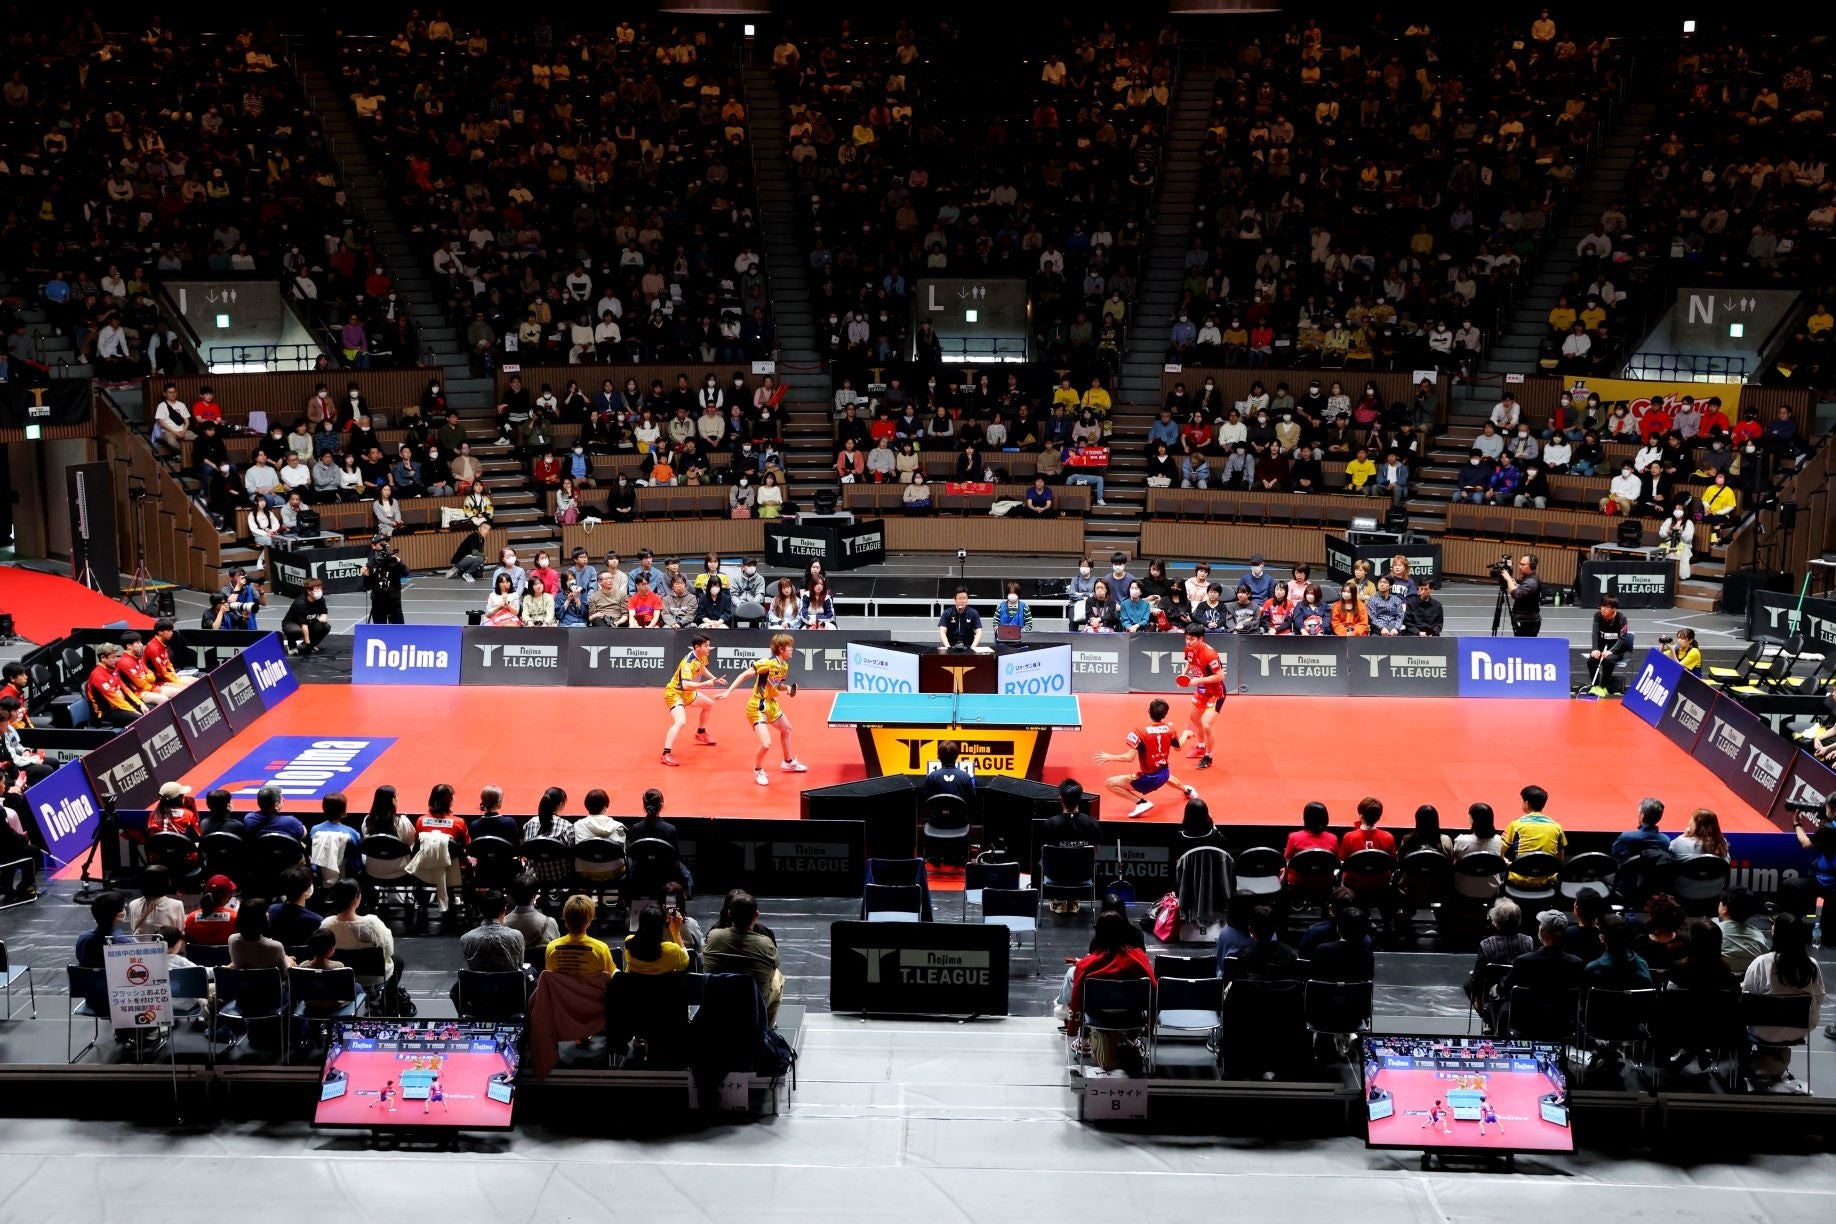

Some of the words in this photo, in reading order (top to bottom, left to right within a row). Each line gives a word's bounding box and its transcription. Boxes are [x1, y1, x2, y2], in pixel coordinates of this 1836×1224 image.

[928, 284, 945, 311] L
[1688, 294, 1715, 324] N
[790, 546, 826, 557] T.LEAGUE
[855, 541, 882, 554] T.LEAGUE
[326, 567, 363, 580] T.LEAGU
[1408, 566, 1434, 576] AGUE
[1617, 584, 1665, 594] T.LEAGUE
[366, 638, 449, 671] Nojima
[503, 656, 558, 669] T.LEAGUE
[609, 657, 665, 669] T.LEAGUE
[1072, 663, 1119, 675] LEAGUE
[1471, 651, 1557, 685] Nojima
[251, 658, 288, 692] Nojima
[1280, 666, 1337, 677] T.LEAGUE
[1390, 667, 1447, 679] T.LEAGUE
[853, 671, 912, 693] RYOYO
[1005, 673, 1065, 695] RYOYO
[1635, 663, 1669, 708] Nojima
[156, 736, 183, 762] T.LEAGUE
[960, 741, 991, 754] Nojima
[117, 766, 149, 794] T.LEAGUE
[1751, 765, 1777, 792] T.LEAGUE
[39, 793, 94, 843] Nojima
[772, 857, 849, 872] T.LEAGUE
[927, 952, 962, 966] Nojima
[899, 968, 990, 985] T.LEAGUE
[112, 988, 167, 998] フラッシュおよび
[113, 996, 169, 1006] ライトを付けての
[121, 1004, 162, 1013] 写真撮影禁止
[1091, 1089, 1143, 1097] コートサイド
[1111, 1099, 1121, 1110] B
